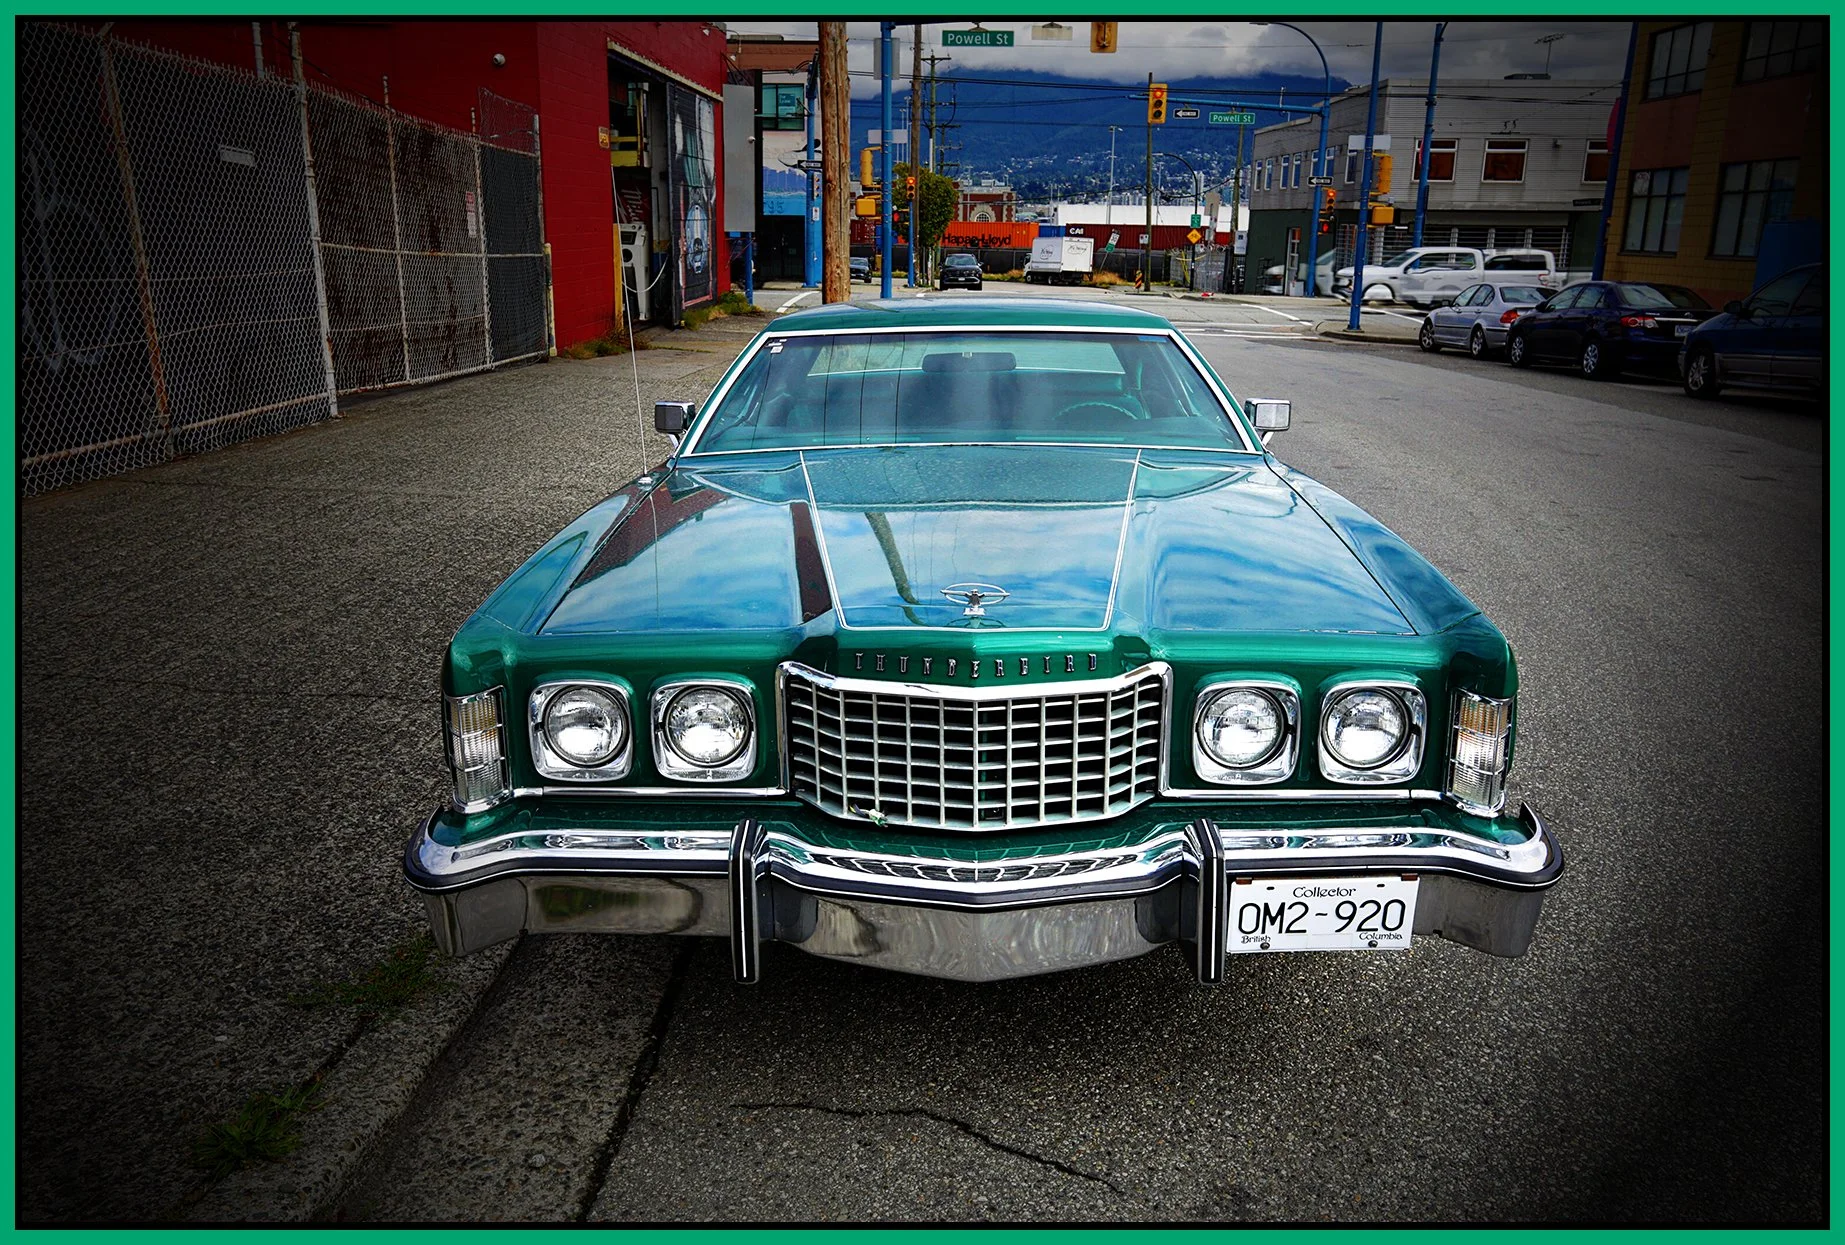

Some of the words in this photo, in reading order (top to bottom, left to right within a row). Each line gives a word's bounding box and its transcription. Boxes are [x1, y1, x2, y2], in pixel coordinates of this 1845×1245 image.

[947, 33, 991, 45] Powell
[996, 33, 1009, 45] St
[1213, 114, 1240, 123] Powell
[1243, 114, 1251, 123] St
[1069, 227, 1084, 235] CAI
[855, 652, 1098, 679] THUNDERBIRD
[1292, 886, 1357, 898] Collector
[1240, 934, 1272, 944] British
[1358, 931, 1403, 941] Columbia
